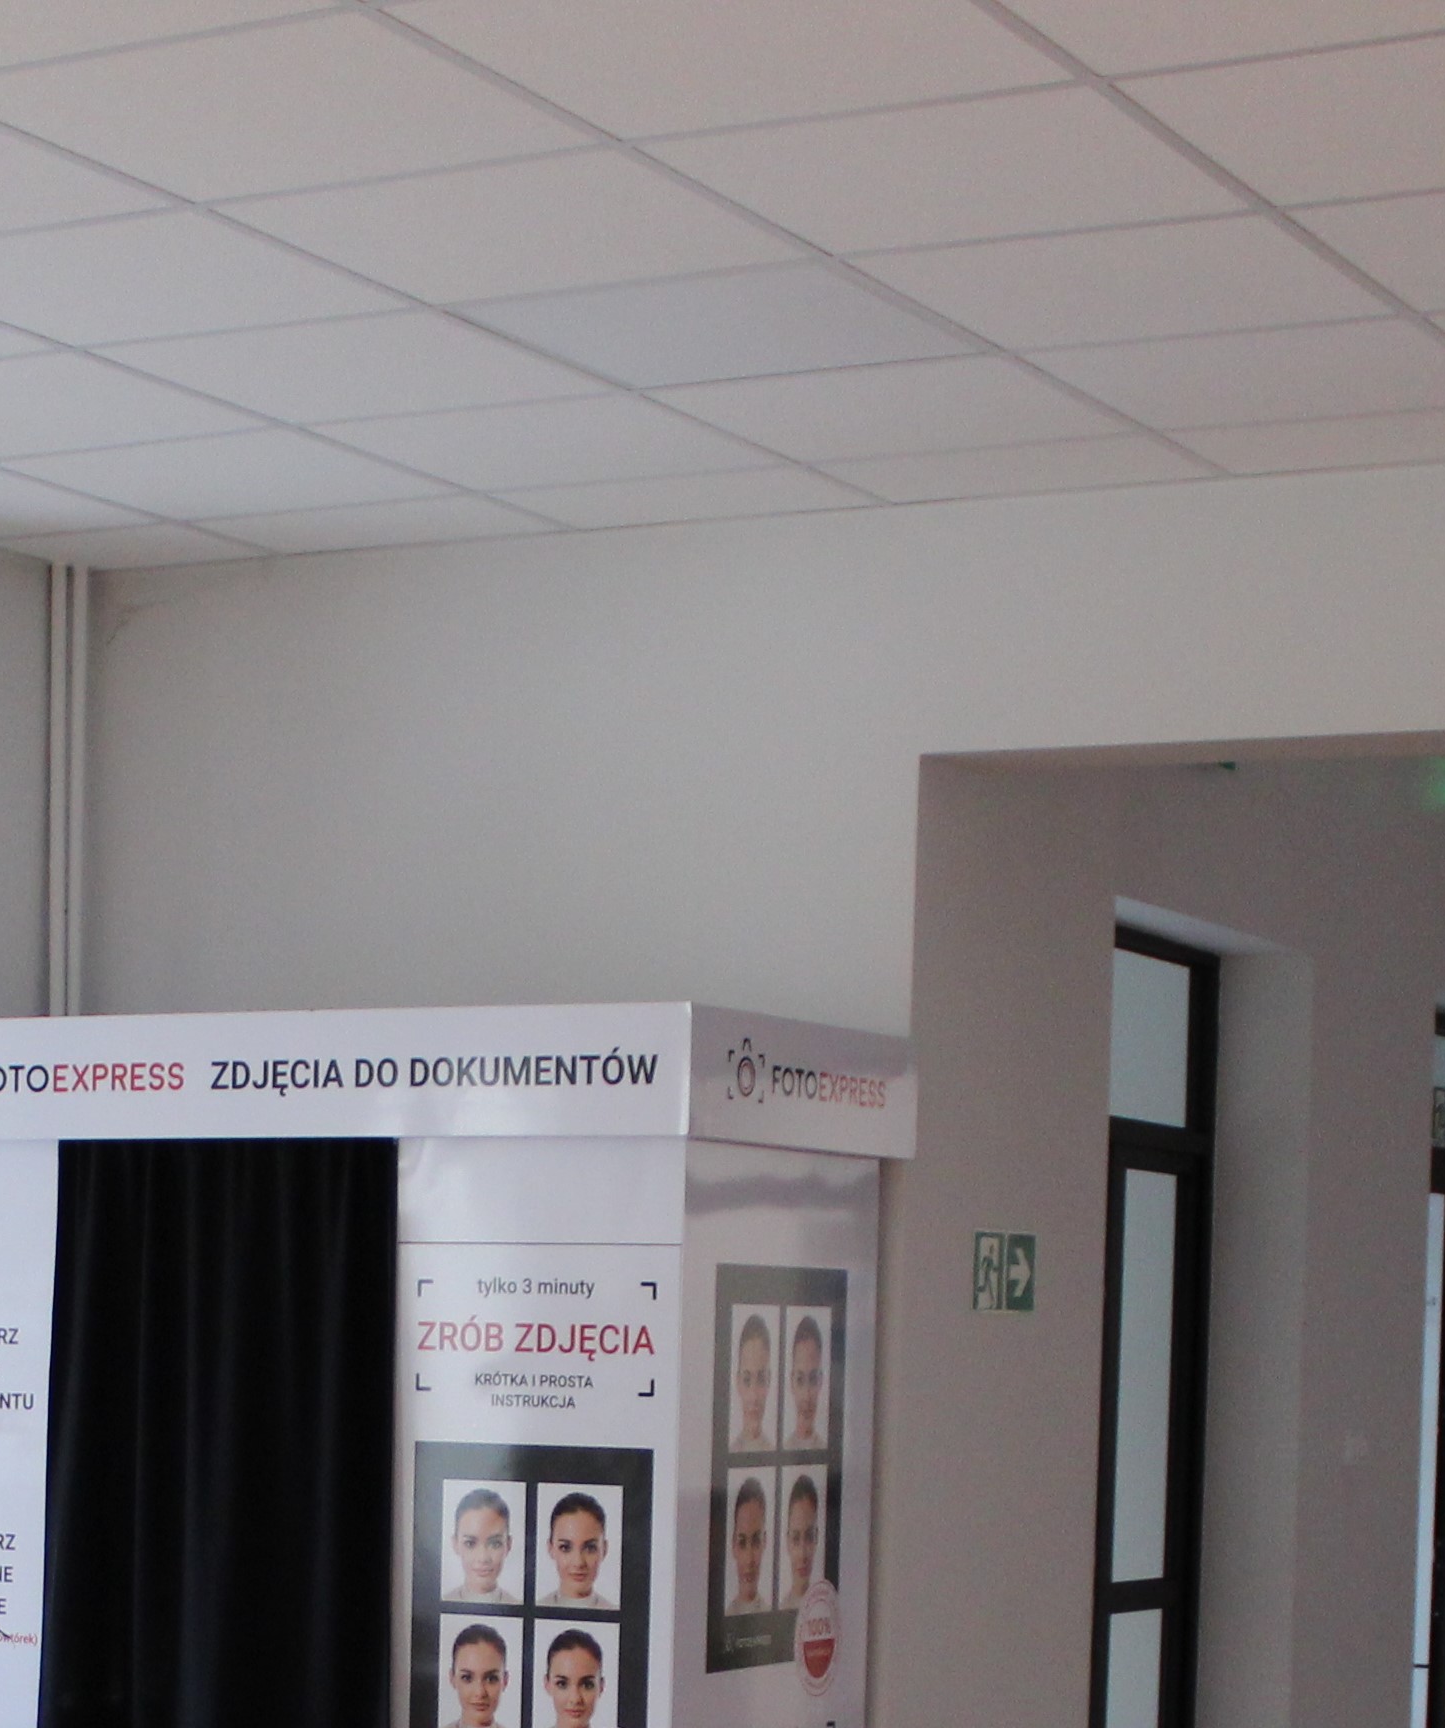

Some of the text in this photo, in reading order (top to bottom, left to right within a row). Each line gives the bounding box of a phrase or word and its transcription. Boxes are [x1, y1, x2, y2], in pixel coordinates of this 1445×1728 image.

[211, 1059, 343, 1096] ZDJĘCIA
[355, 1058, 398, 1087] DO
[410, 1047, 657, 1087] DOKUMENTÓW
[771, 1064, 884, 1106] FOTOEXPRESS
[478, 1276, 596, 1298] tylko 3 minuty
[415, 1316, 654, 1362] ZRÓB ZDJĘCIA
[475, 1371, 593, 1388] KRÓTKA I PROSTA
[490, 1393, 577, 1410] INSTRUKCJA
